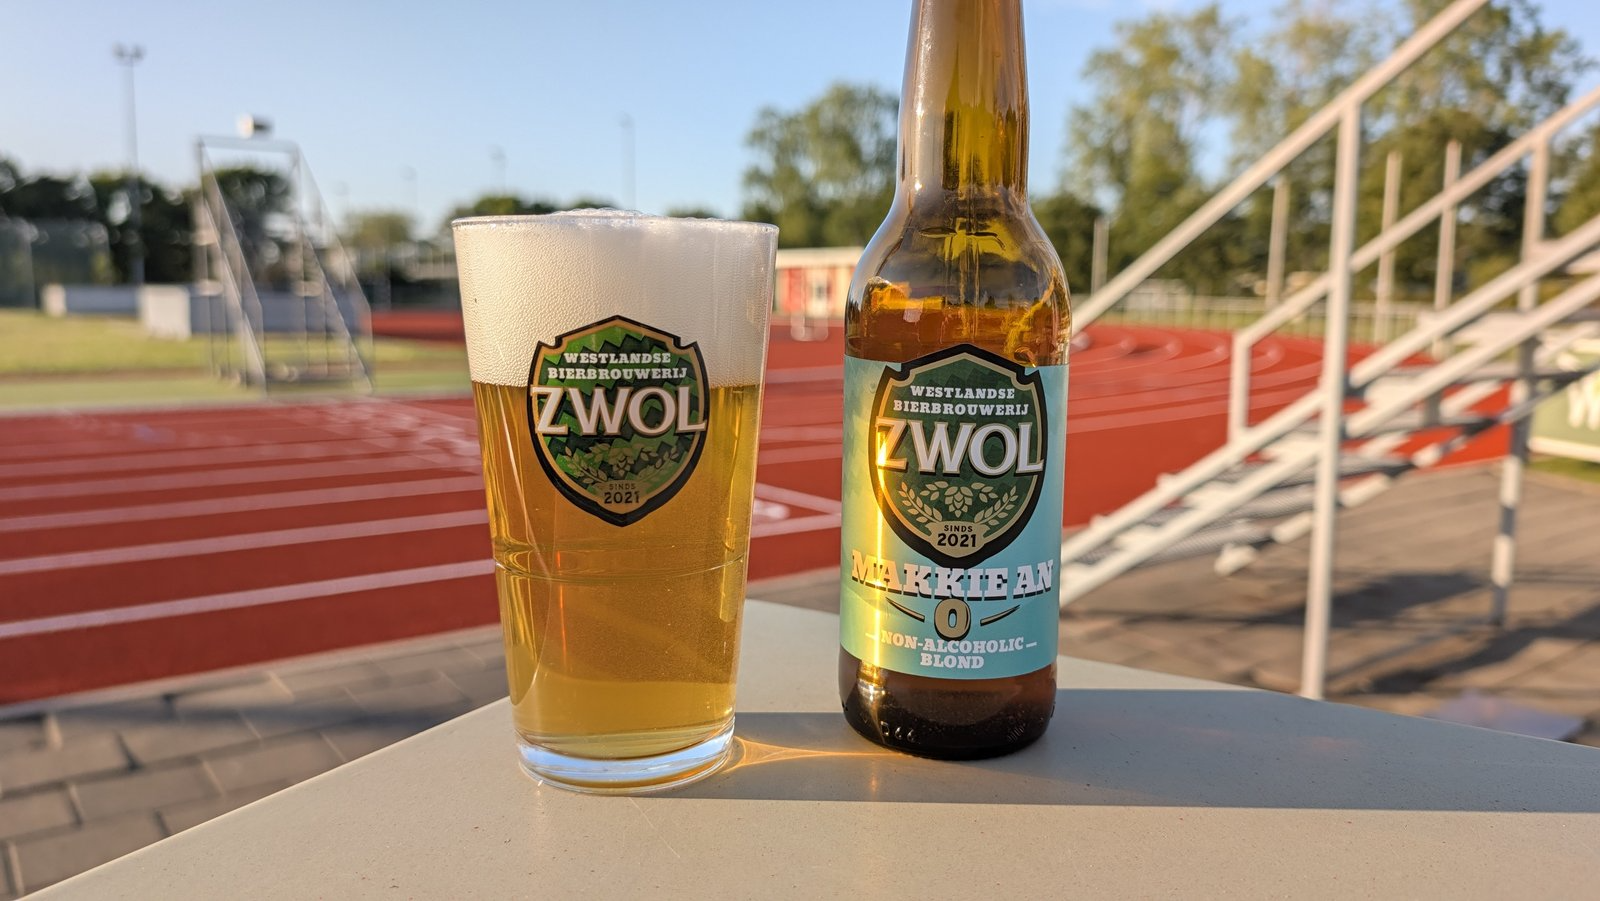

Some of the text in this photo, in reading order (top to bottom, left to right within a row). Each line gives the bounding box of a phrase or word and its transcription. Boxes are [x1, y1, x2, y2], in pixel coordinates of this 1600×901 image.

[564, 352, 671, 364] WESTLANDSE
[547, 367, 688, 380] BIERBROUWERIJ
[910, 385, 1016, 401] WESTLANDSE
[530, 385, 708, 437] ZWOL
[893, 399, 1030, 416] BIERBROUWERIJ
[874, 416, 1045, 476] ZWOL
[603, 491, 640, 504] 2021
[943, 523, 974, 533] SINDS
[937, 533, 977, 548] 2021
[851, 549, 1054, 601] MAKKIE AN
[880, 629, 1025, 653] NON-ALCOHOLIC
[920, 652, 985, 670] BLOND
